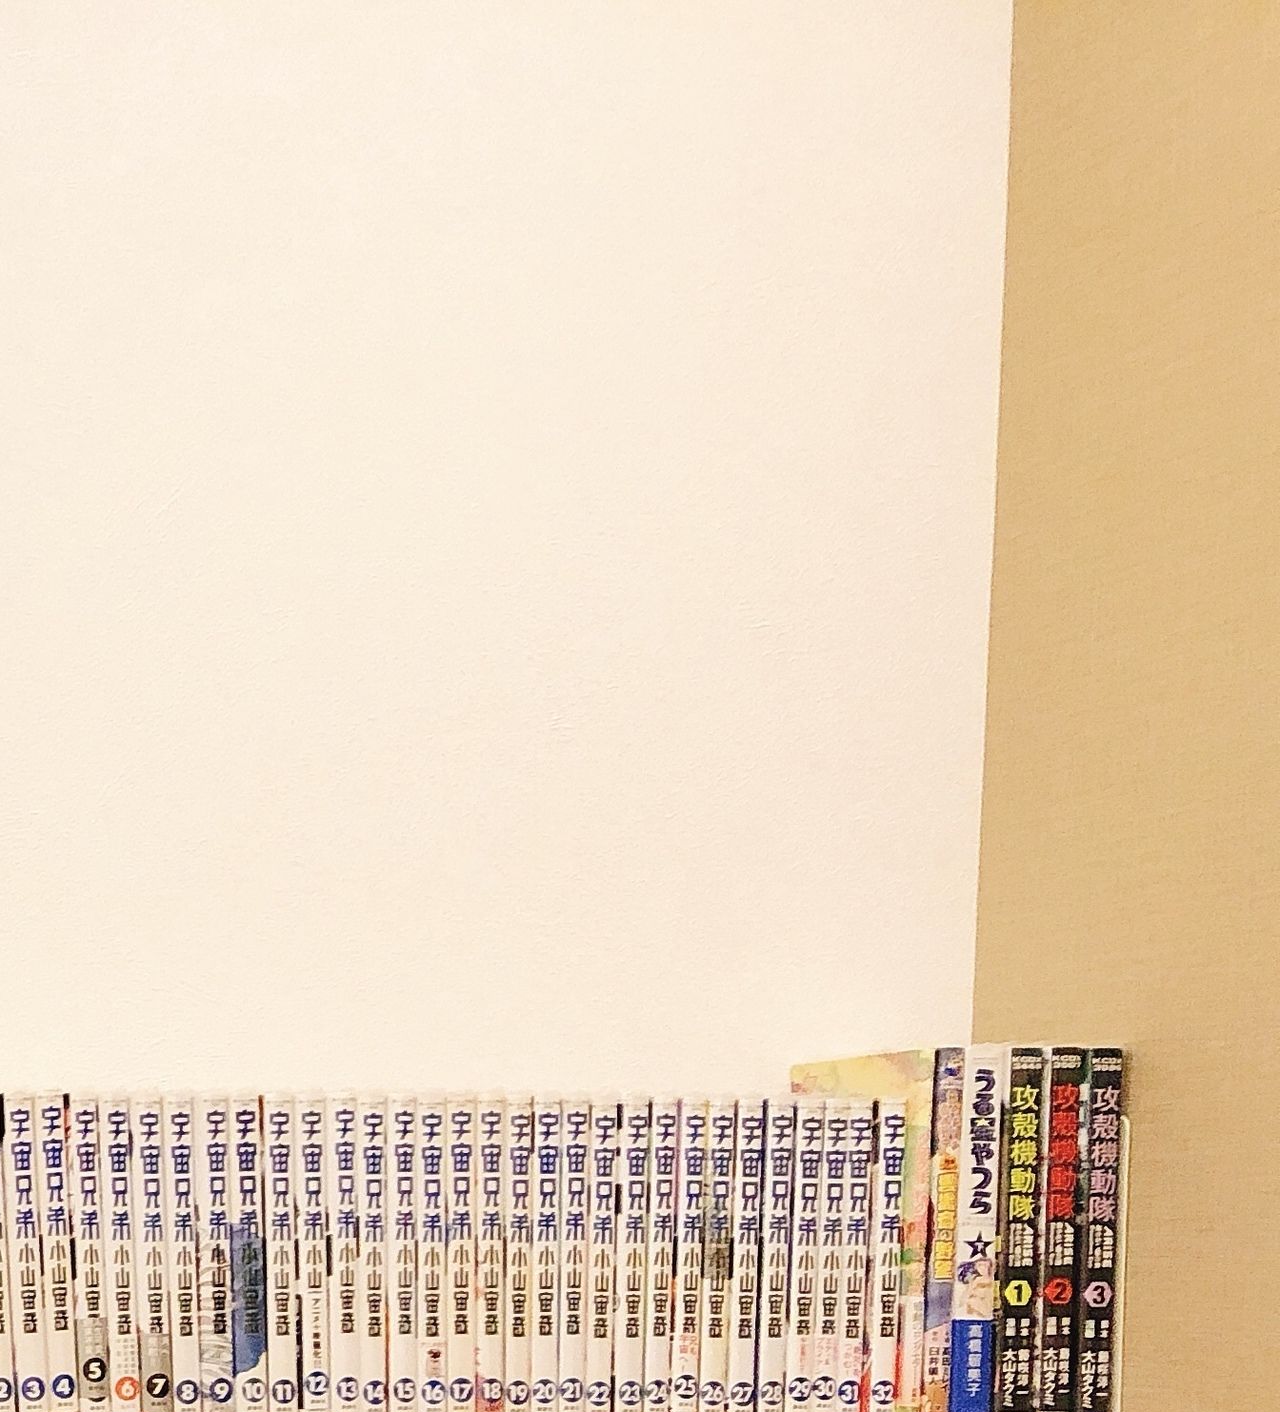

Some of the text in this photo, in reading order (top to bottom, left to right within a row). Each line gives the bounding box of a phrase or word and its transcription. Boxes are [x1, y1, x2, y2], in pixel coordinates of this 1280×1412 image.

[42, 1106, 68, 1236] 宇宙兄弟
[171, 1110, 191, 1242] 宇宙兄弟
[566, 1110, 587, 1241] 宇宙兄弟
[739, 1116, 762, 1246] 宇宙兄弟
[969, 1068, 996, 1215] うる星やつら
[1007, 1084, 1039, 1222] 攻殻機動隊
[1045, 1082, 1080, 1221] 攻殻機動隊
[1087, 1085, 1122, 1223] 攻殻機動隊
[50, 1239, 69, 1331] 小山宙哉
[176, 1245, 194, 1336] 小山宙哉
[566, 1244, 582, 1335] 小山宙哉
[739, 1248, 755, 1340] 小山宙哉
[1014, 1284, 1023, 1303] 1
[1054, 1279, 1065, 1299] 2
[1093, 1285, 1105, 1304] 3
[55, 1377, 72, 1396] 4
[181, 1383, 195, 1399] 8
[562, 1381, 581, 1398] 21
[733, 1385, 753, 1401] 27
